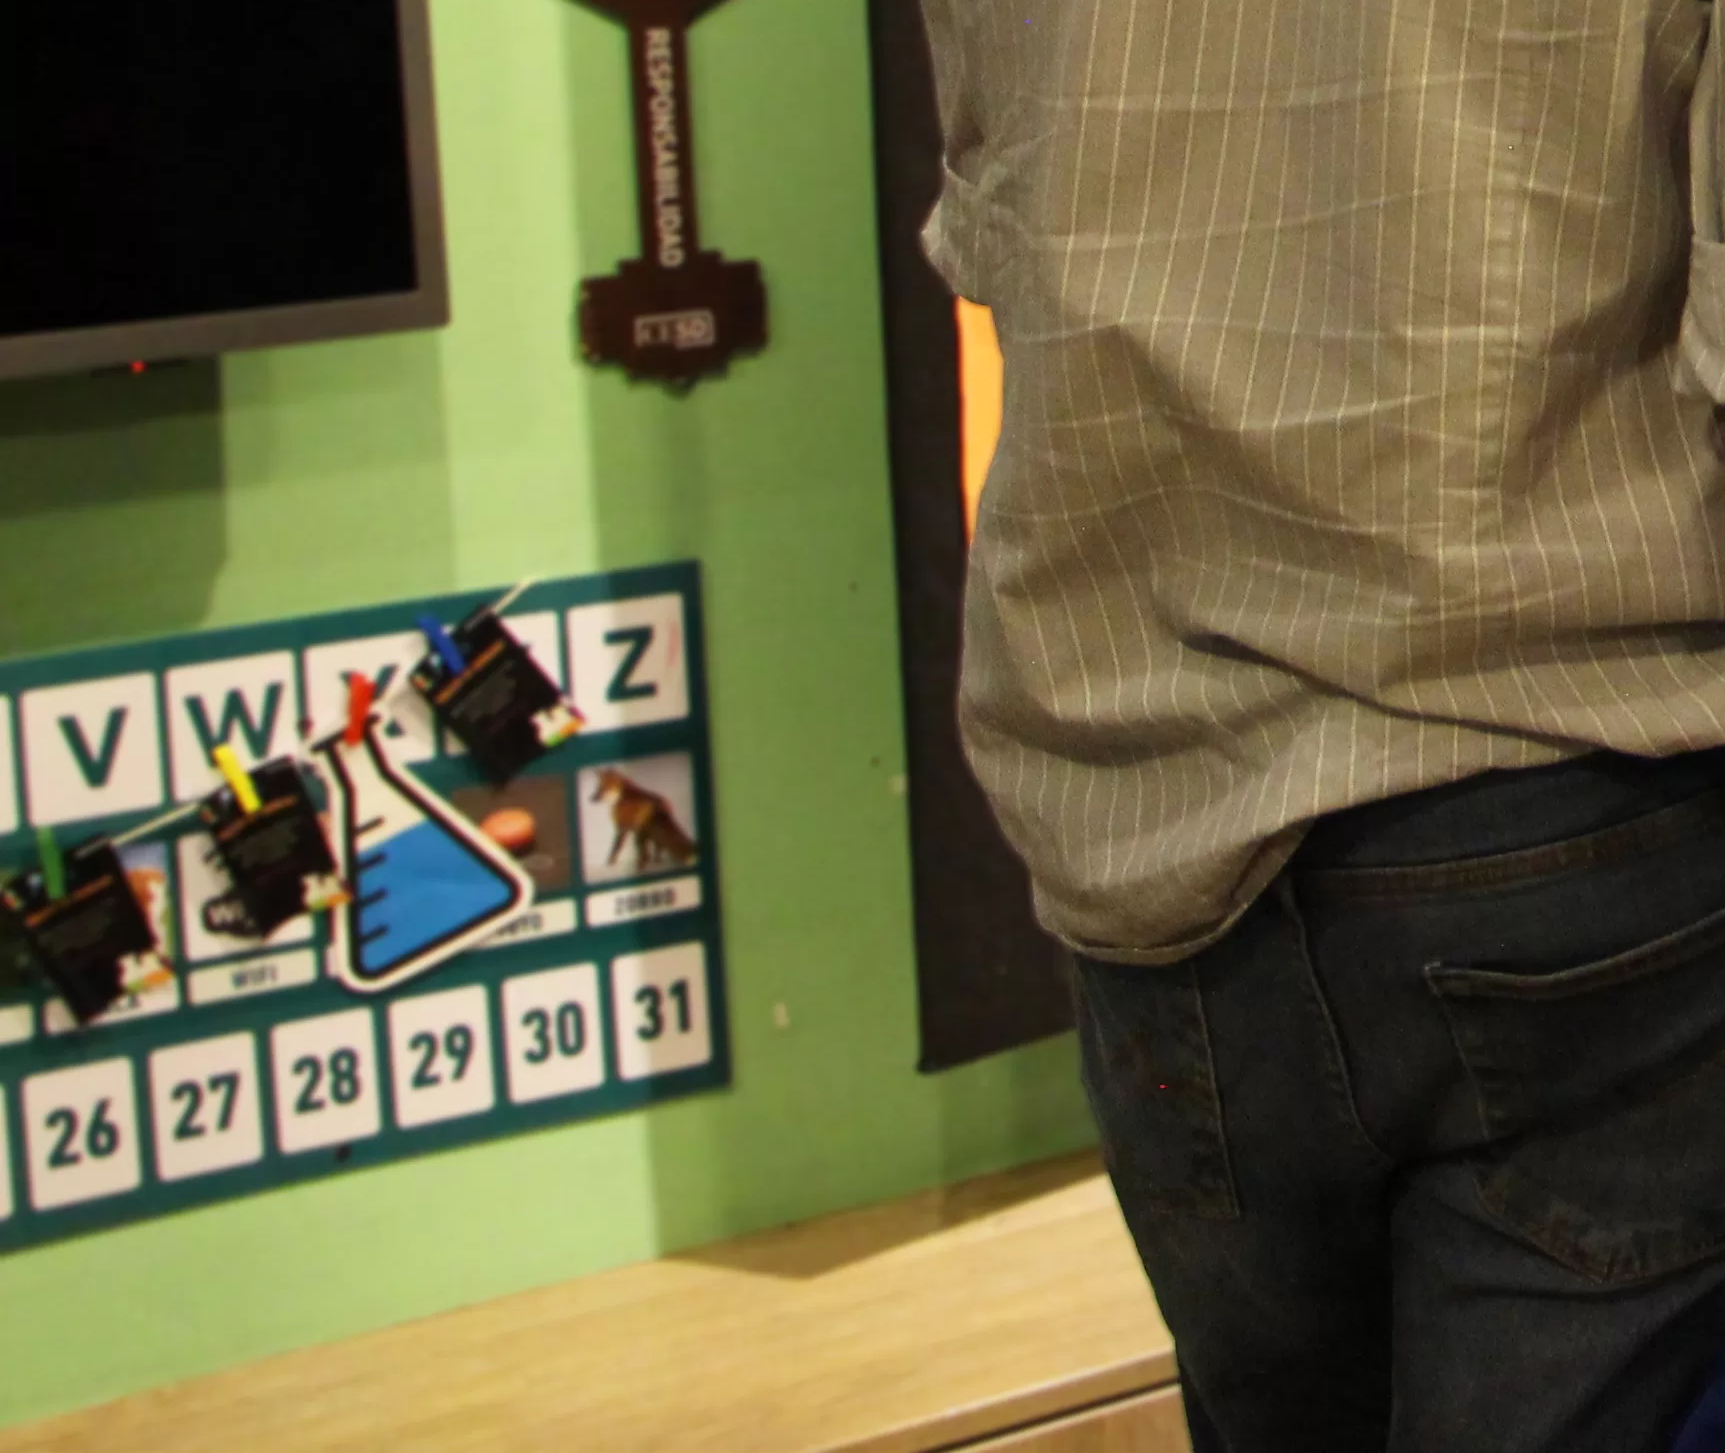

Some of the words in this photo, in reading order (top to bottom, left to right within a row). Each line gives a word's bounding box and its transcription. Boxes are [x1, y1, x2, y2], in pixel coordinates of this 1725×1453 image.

[645, 29, 684, 266] RESPONSABILIDAD
[602, 624, 659, 702] Z
[58, 706, 129, 789] V
[185, 681, 285, 769] W
[45, 1097, 120, 1169] 26
[171, 1072, 242, 1143] 27
[292, 1047, 362, 1114] 28
[408, 1024, 474, 1089] 29
[523, 1000, 585, 1066] 30
[635, 979, 692, 1042] 31
